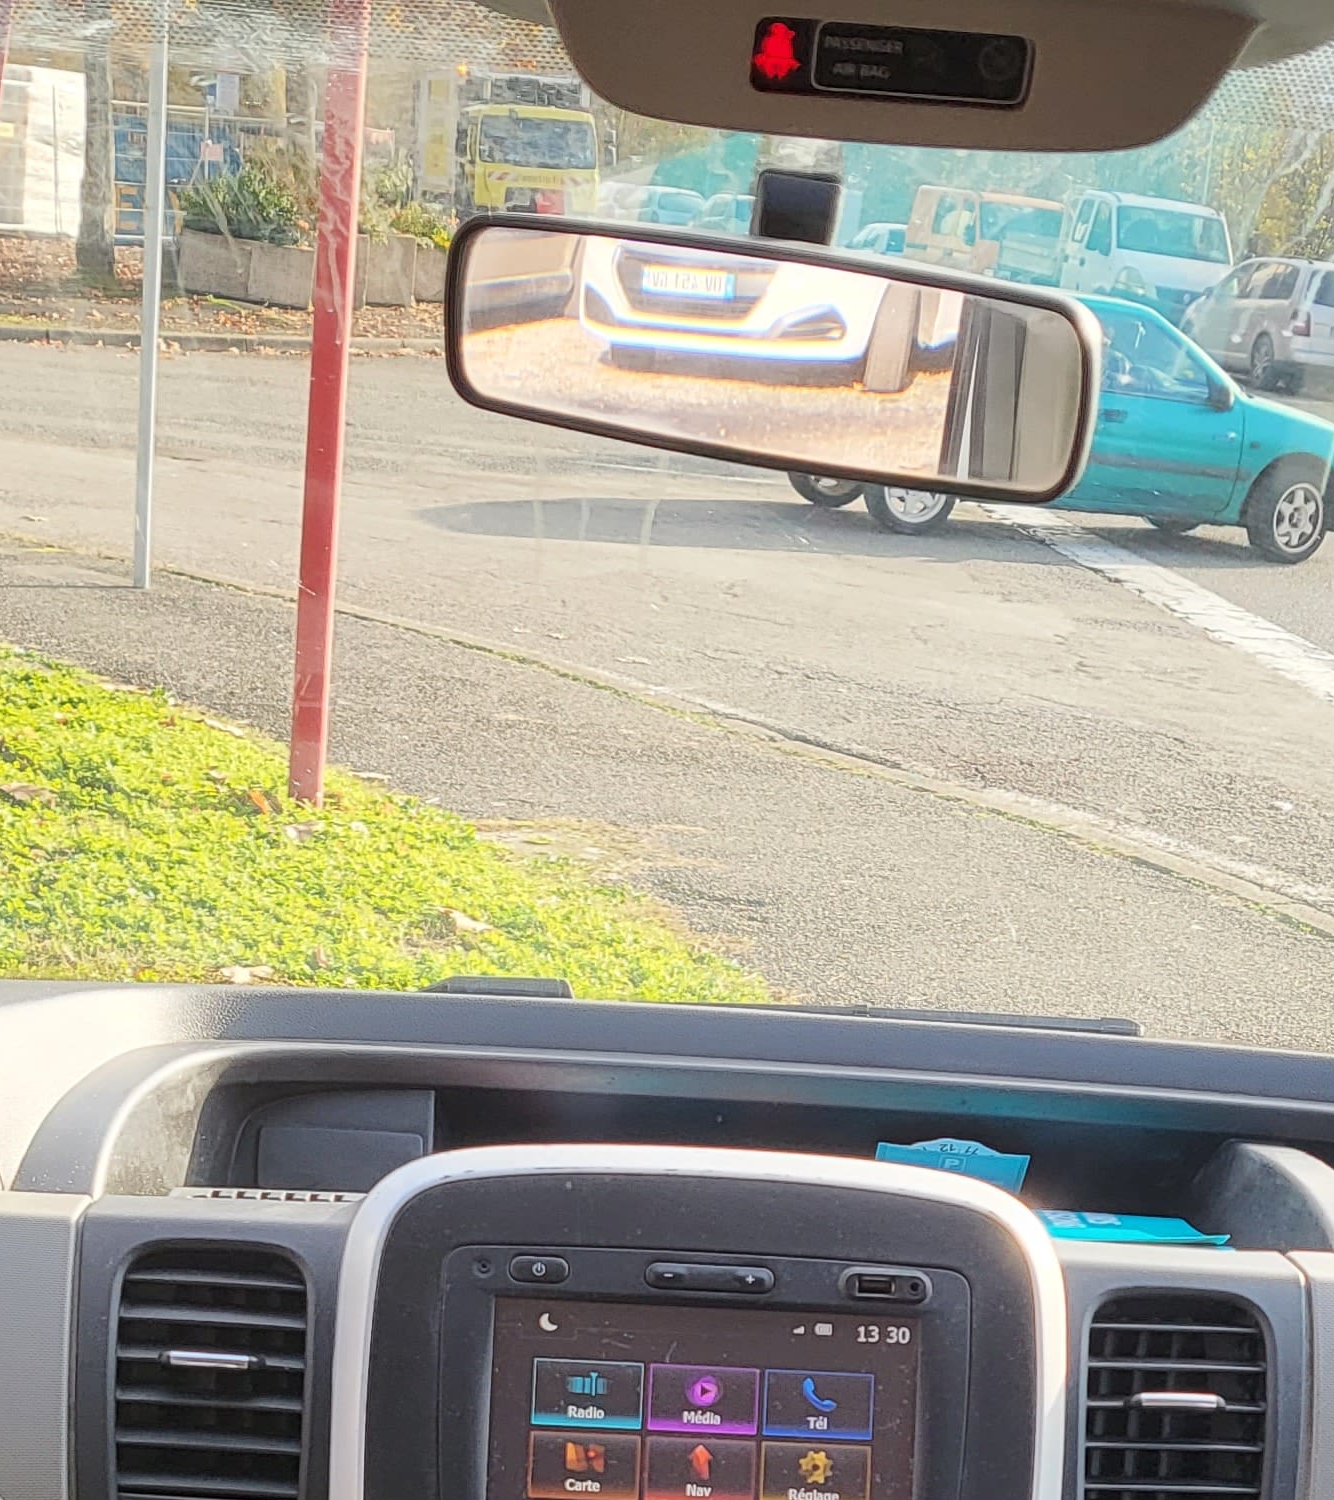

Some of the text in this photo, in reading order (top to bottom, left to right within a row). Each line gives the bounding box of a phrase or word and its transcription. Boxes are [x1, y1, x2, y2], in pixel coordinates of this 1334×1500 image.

[824, 35, 904, 55] PASSENGER
[859, 63, 891, 80] BAG
[856, 1325, 911, 1344] 13 30
[567, 1405, 605, 1420] Radio
[682, 1410, 722, 1426] Média
[806, 1416, 828, 1430] Tél
[564, 1478, 602, 1493] Carte
[685, 1484, 712, 1498] Nav
